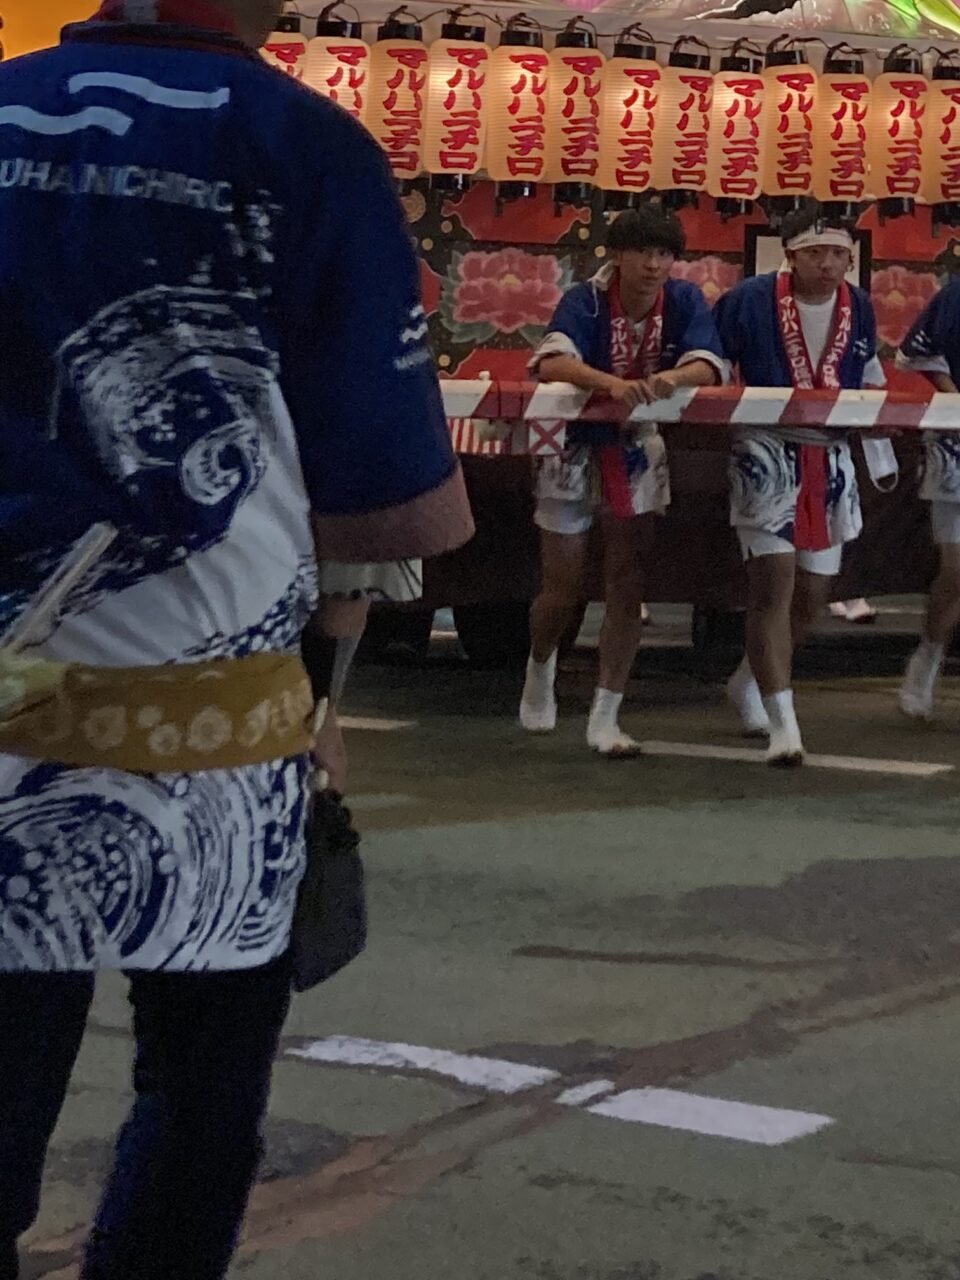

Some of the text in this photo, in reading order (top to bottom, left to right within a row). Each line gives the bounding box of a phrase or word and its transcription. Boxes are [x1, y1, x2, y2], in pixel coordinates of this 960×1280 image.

[438, 48, 490, 170] マルハニチロ
[506, 53, 551, 178] マルハニチロ
[560, 54, 603, 177] マルハニチロ
[614, 68, 662, 187] マルハニチロ
[671, 75, 714, 187] マルハニチロ
[718, 78, 766, 197] マルハニチロ
[775, 72, 817, 190] マルハニチロ
[828, 80, 871, 198] マルハニチロ
[885, 79, 929, 196] マルハニチロ
